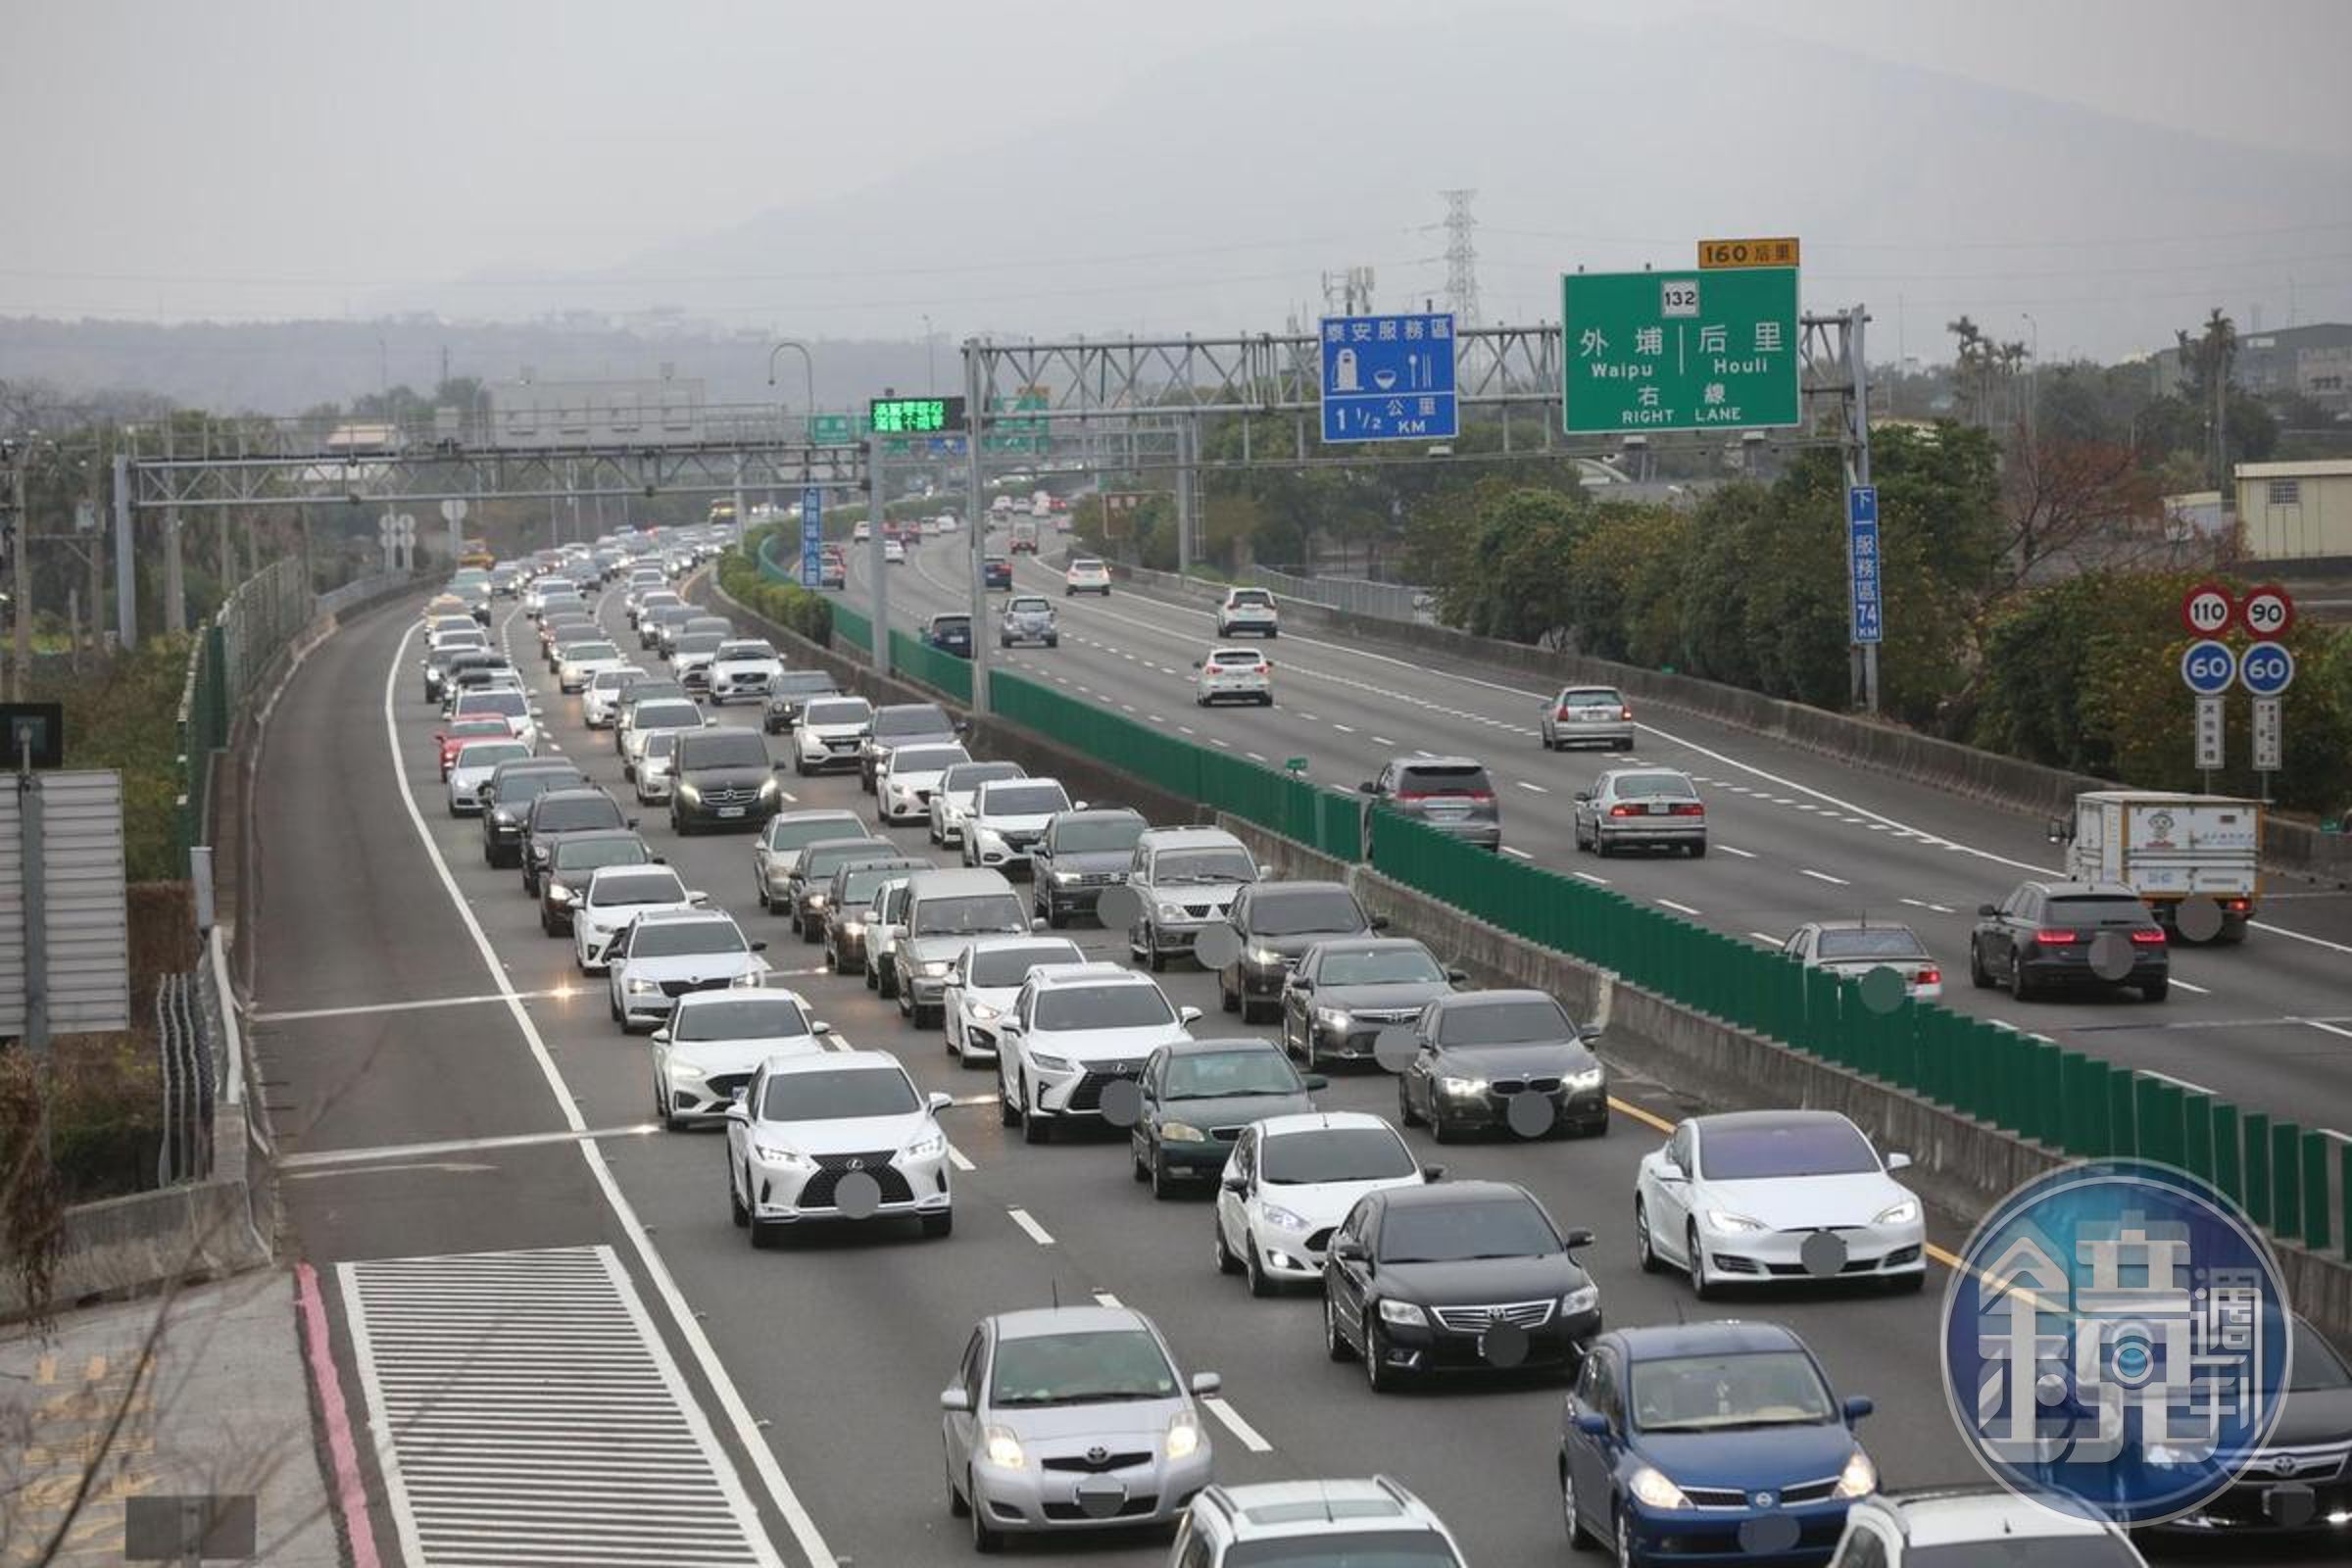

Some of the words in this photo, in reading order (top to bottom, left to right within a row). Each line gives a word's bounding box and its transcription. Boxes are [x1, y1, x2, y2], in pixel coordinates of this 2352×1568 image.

[1706, 245, 1747, 263] 160
[1665, 291, 1696, 306] 132
[1325, 318, 1450, 342] 泰安服務區
[1698, 321, 1783, 353] 后里
[1580, 326, 1663, 357] 外埔
[1591, 363, 1653, 379] Waipu
[1714, 358, 1768, 373] Houli
[1638, 382, 1726, 406] 右線
[1387, 397, 1436, 416] 公里
[1622, 409, 1675, 424] RIGHT
[1694, 407, 1741, 422] LANE
[1397, 419, 1426, 433] KM
[1857, 604, 1878, 625] 74
[2194, 603, 2226, 621] 110
[2252, 604, 2282, 622] 90
[2190, 658, 2228, 678] 60
[2248, 659, 2285, 679] 60
